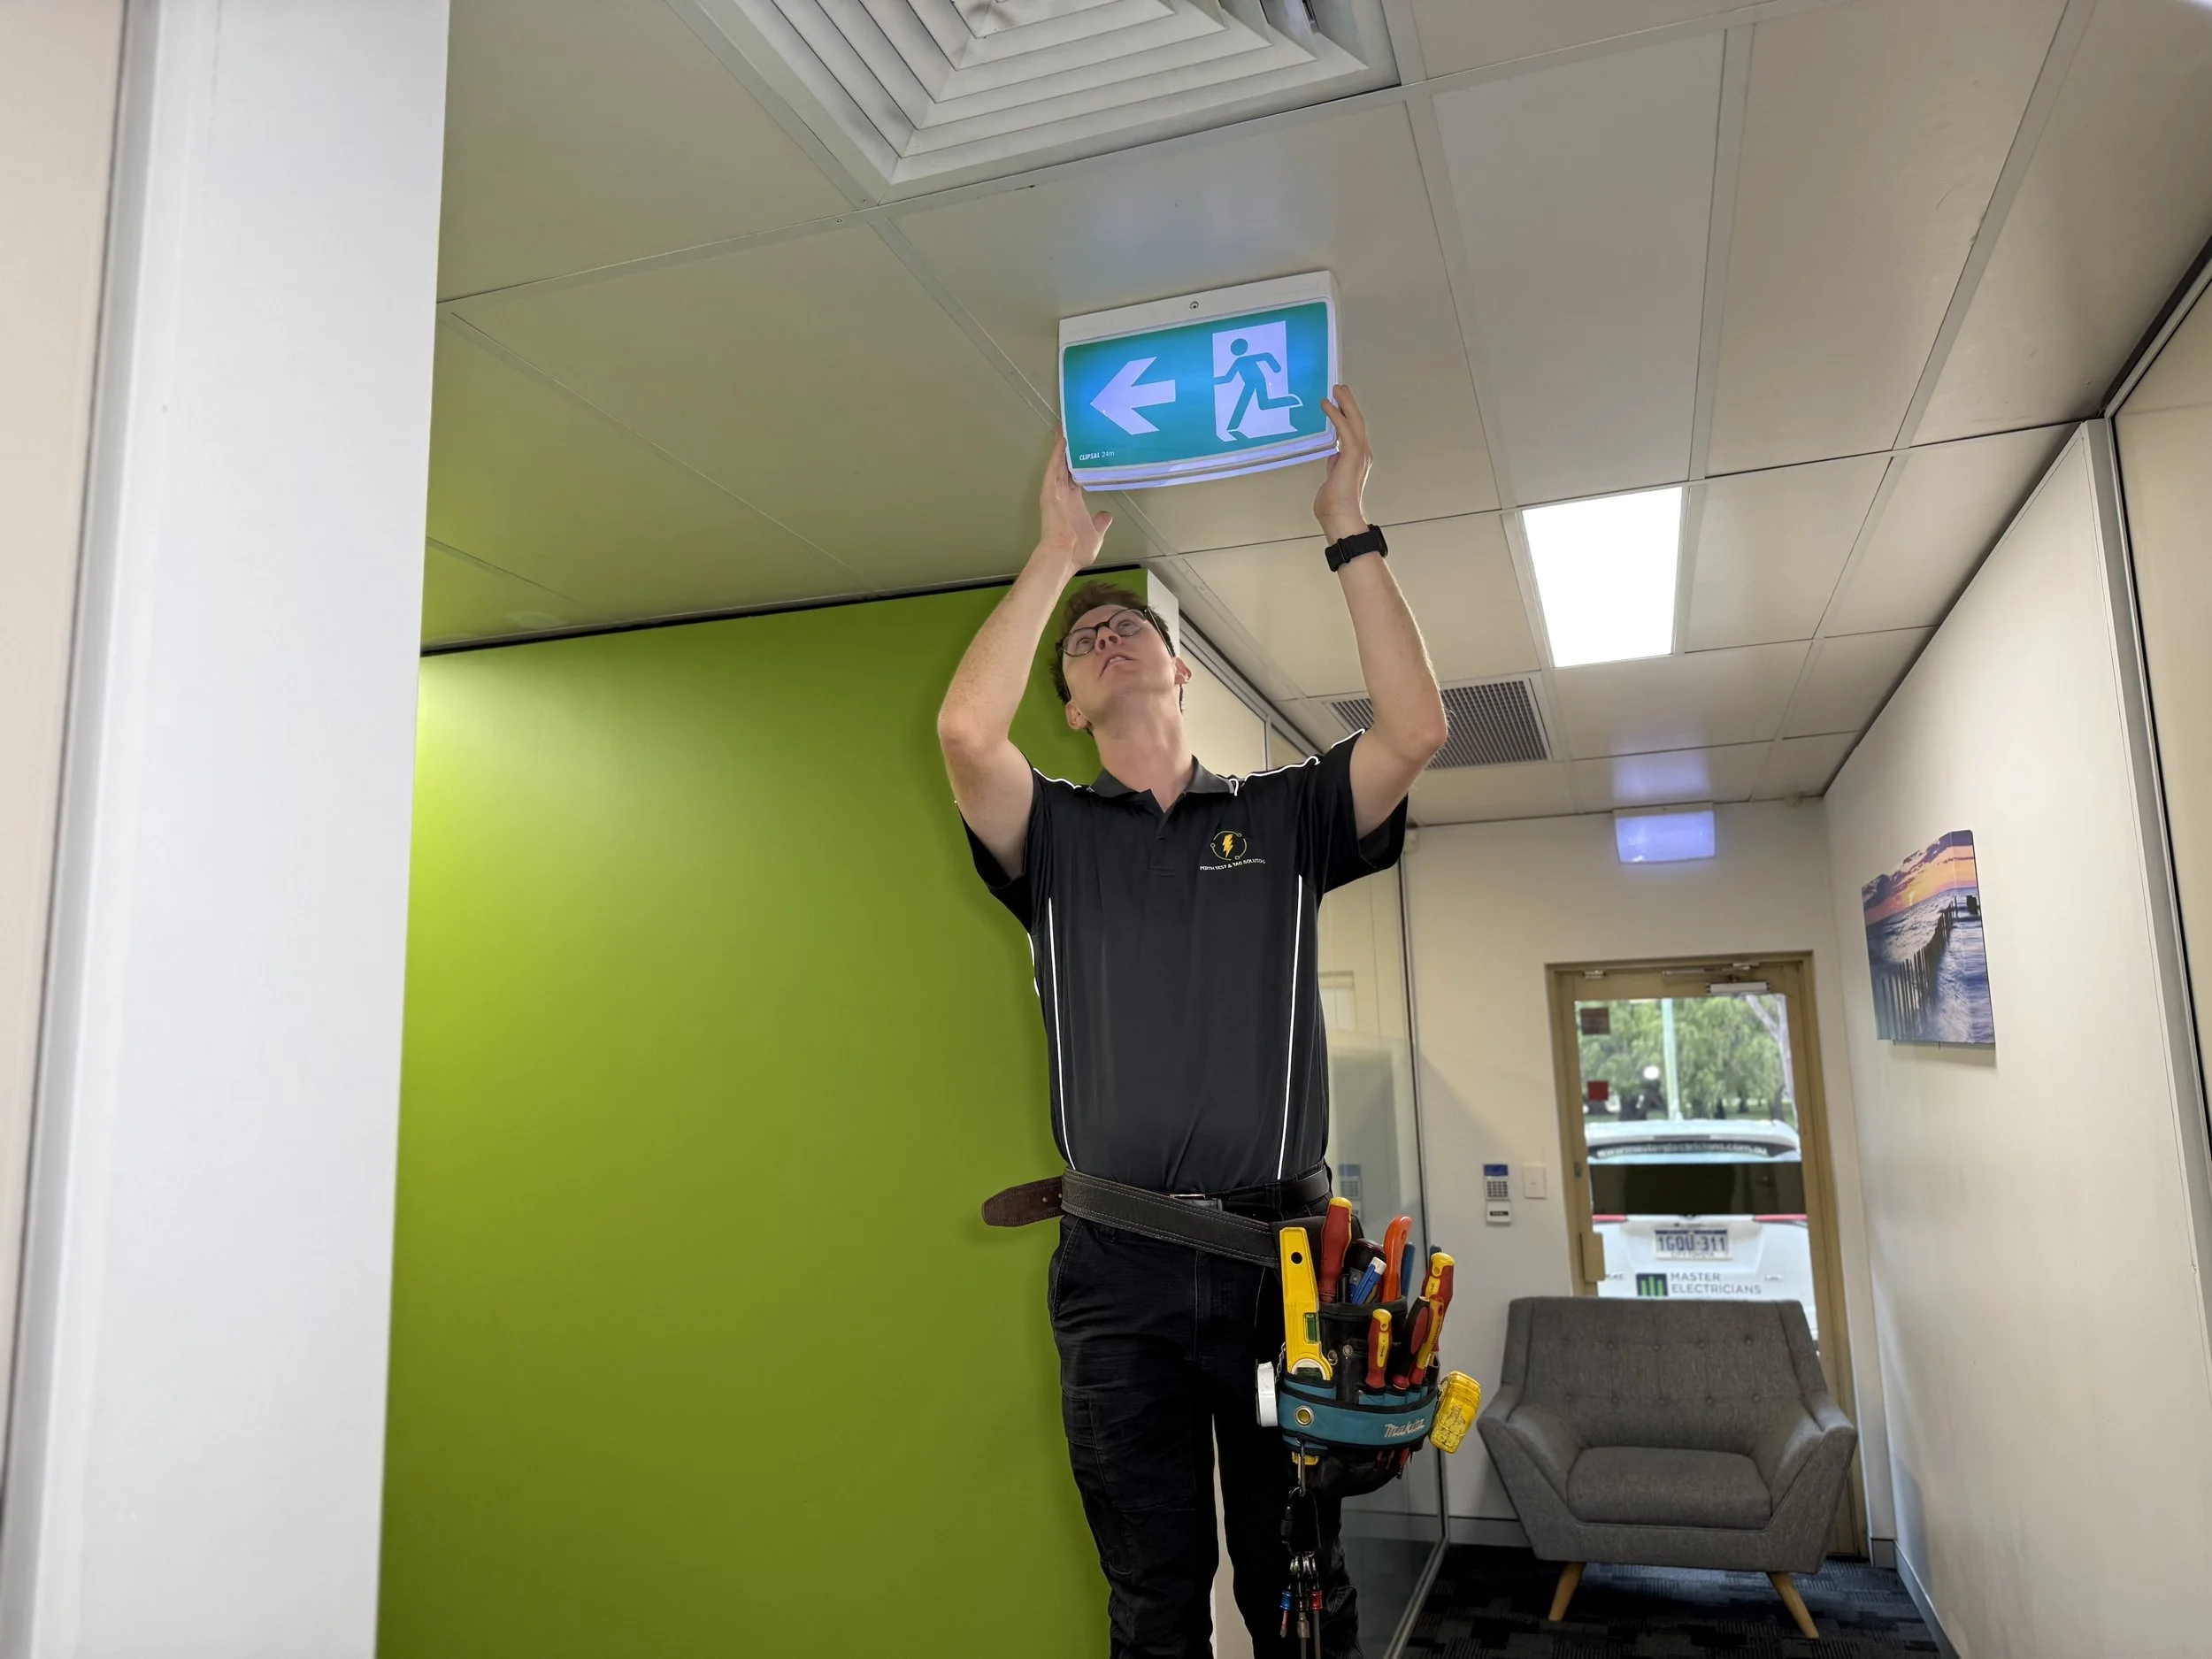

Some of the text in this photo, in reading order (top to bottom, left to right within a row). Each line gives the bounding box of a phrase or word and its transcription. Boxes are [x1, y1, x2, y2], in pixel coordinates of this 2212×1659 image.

[1079, 452, 1100, 461] CLIPSAL
[1671, 1272, 1721, 1282] MASTER
[1671, 1284, 1762, 1295] ELECTRICIANS
